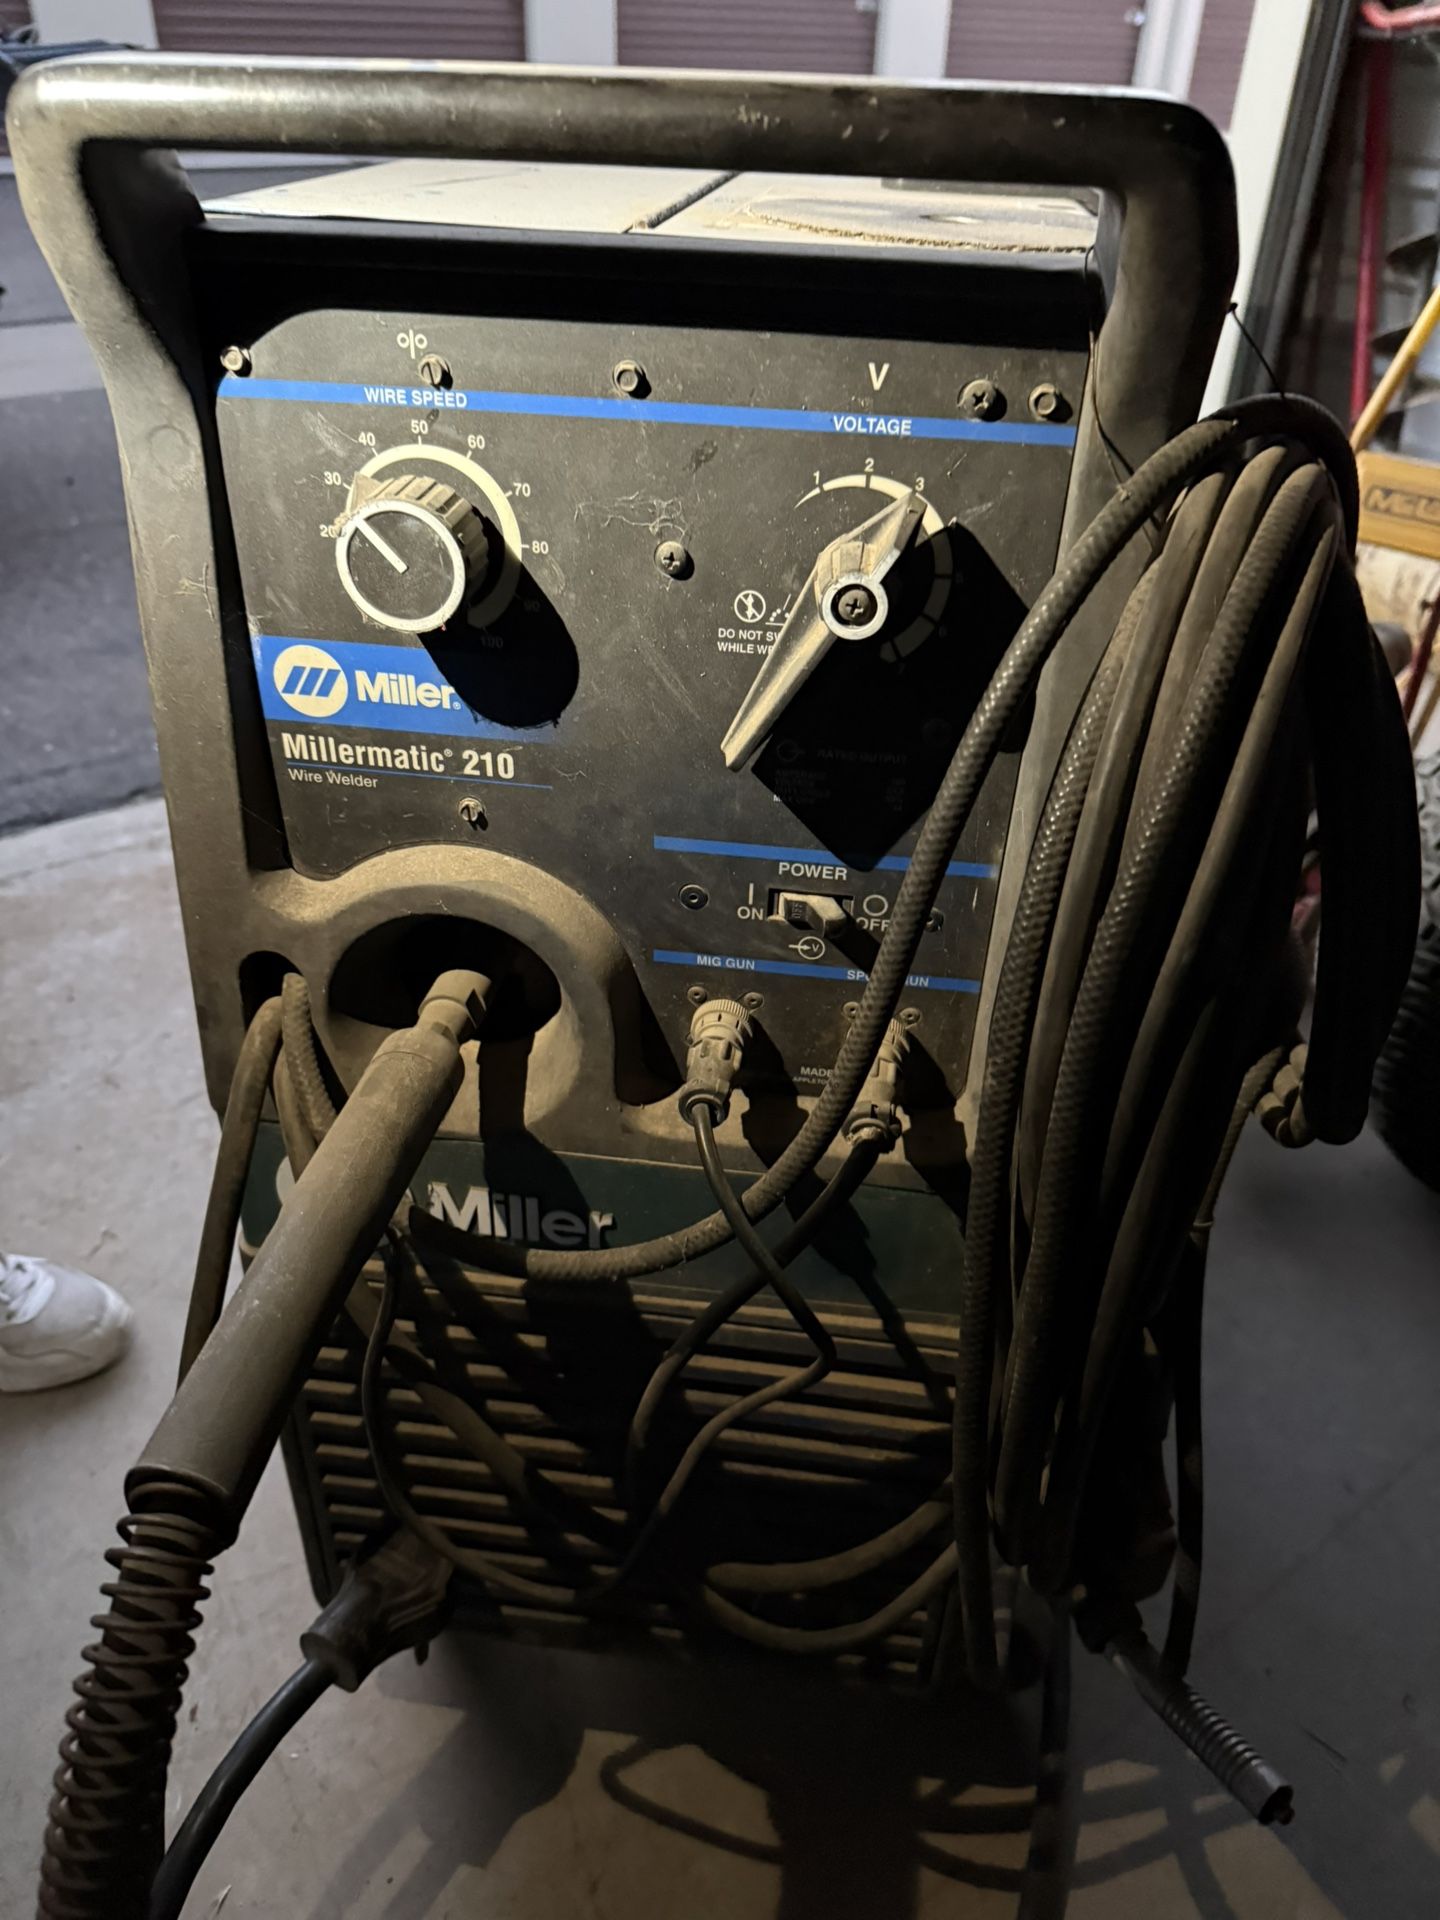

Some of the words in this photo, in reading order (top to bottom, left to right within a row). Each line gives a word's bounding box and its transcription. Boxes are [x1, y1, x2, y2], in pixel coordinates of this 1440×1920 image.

[868, 362, 890, 391] V
[364, 387, 407, 405] WIRE
[411, 390, 467, 408] SPEED
[411, 419, 429, 434] 50
[833, 415, 913, 436] VOLTAGE
[358, 432, 376, 447] 40
[467, 435, 486, 449] 60
[864, 457, 875, 472] 2
[323, 471, 342, 486] 30
[813, 471, 821, 485] 1
[914, 476, 925, 491] 3
[513, 482, 532, 498] 70
[531, 541, 549, 555] 80
[718, 627, 736, 639] DO
[739, 629, 763, 641] NOT
[480, 635, 504, 649] 100
[717, 641, 755, 654] WHILE
[462, 750, 515, 780] 210
[288, 768, 323, 784] Wire
[325, 770, 378, 789] Welder
[778, 862, 847, 881] POWER
[737, 906, 764, 921] ON
[856, 917, 890, 932] OFF
[697, 955, 721, 968] MIG
[725, 957, 756, 970] GUN
[905, 975, 929, 988] UN
[428, 1181, 614, 1250] Miller
